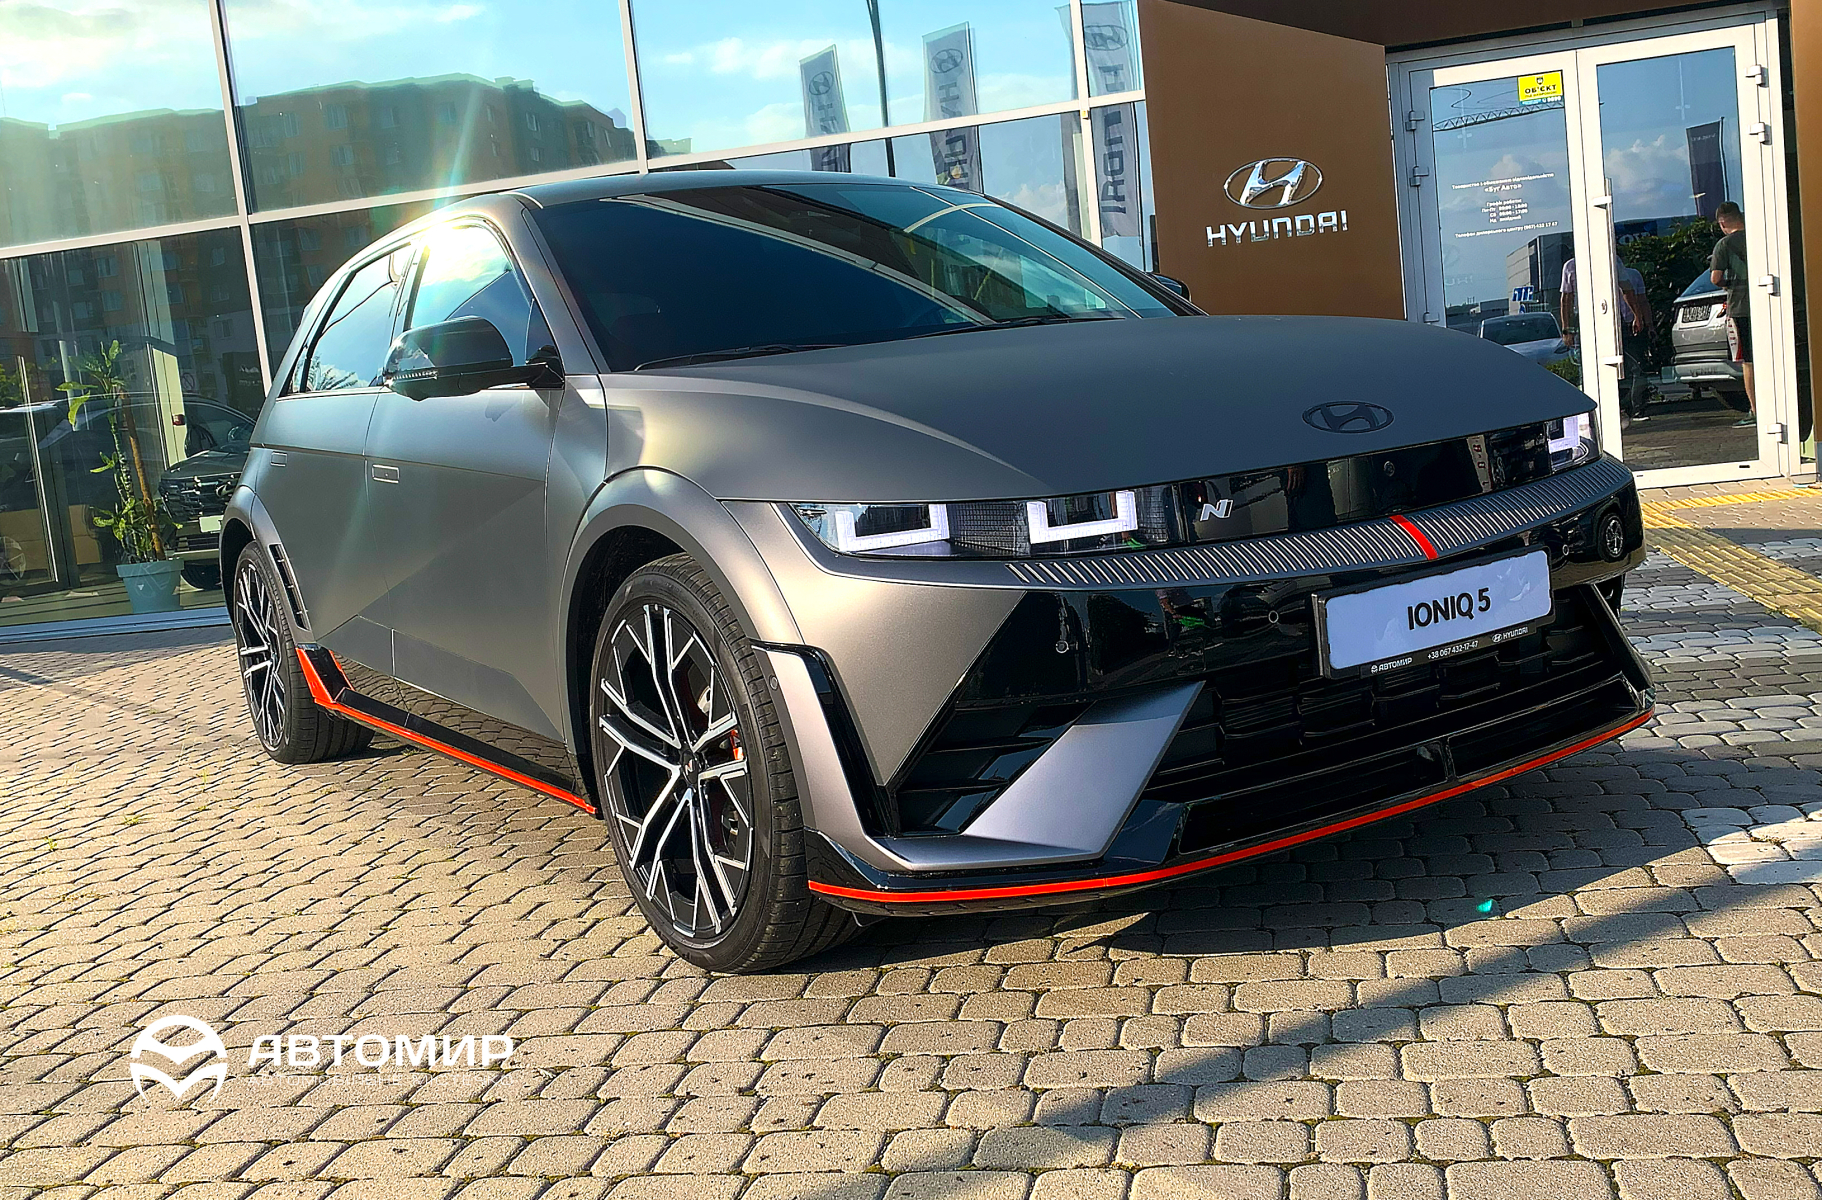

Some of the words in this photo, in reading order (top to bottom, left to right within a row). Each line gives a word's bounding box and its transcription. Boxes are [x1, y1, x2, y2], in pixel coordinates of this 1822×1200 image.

[1205, 209, 1349, 248] HYUNDAI
[1407, 592, 1475, 631] IONIQ
[1477, 587, 1492, 612] 5
[1502, 626, 1529, 641] HYUNDAI
[1427, 650, 1439, 660] +38
[1439, 647, 1451, 657] 067
[1451, 640, 1479, 654] 432-17-47
[1378, 656, 1413, 672] АВТОМИР
